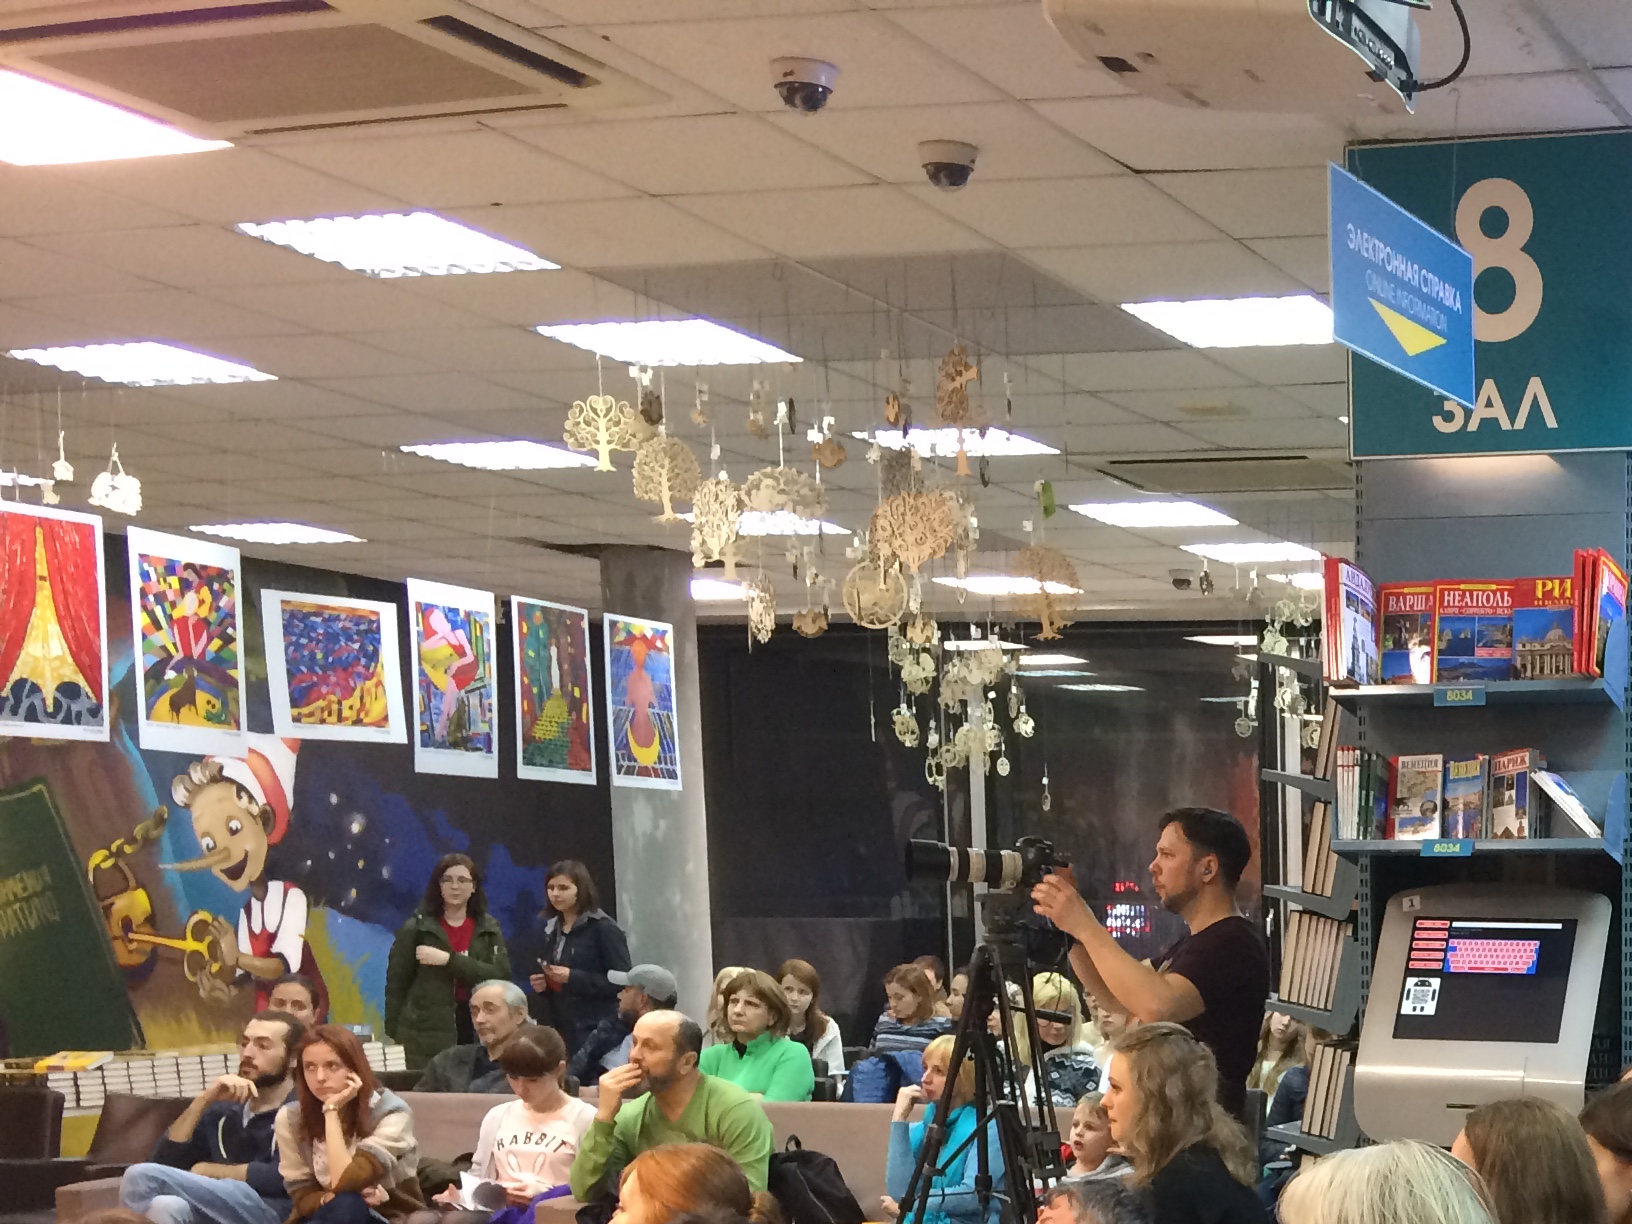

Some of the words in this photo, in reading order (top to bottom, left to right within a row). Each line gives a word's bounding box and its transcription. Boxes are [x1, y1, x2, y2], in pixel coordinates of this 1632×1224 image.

[1347, 223, 1420, 288] ЭЛЕКТРОННАЯ
[1420, 269, 1462, 314] СПРАВКА
[1455, 177, 1543, 342] 8
[1365, 269, 1395, 304] ONLINE
[1432, 377, 1558, 433] ЗАЛ
[1444, 591, 1512, 607] НЕАПОЛЬ
[1446, 690, 1473, 701] 8034
[1494, 754, 1527, 772] ПАРИЖ
[1408, 899, 1415, 909] 1
[496, 1130, 568, 1153] RABBIT
